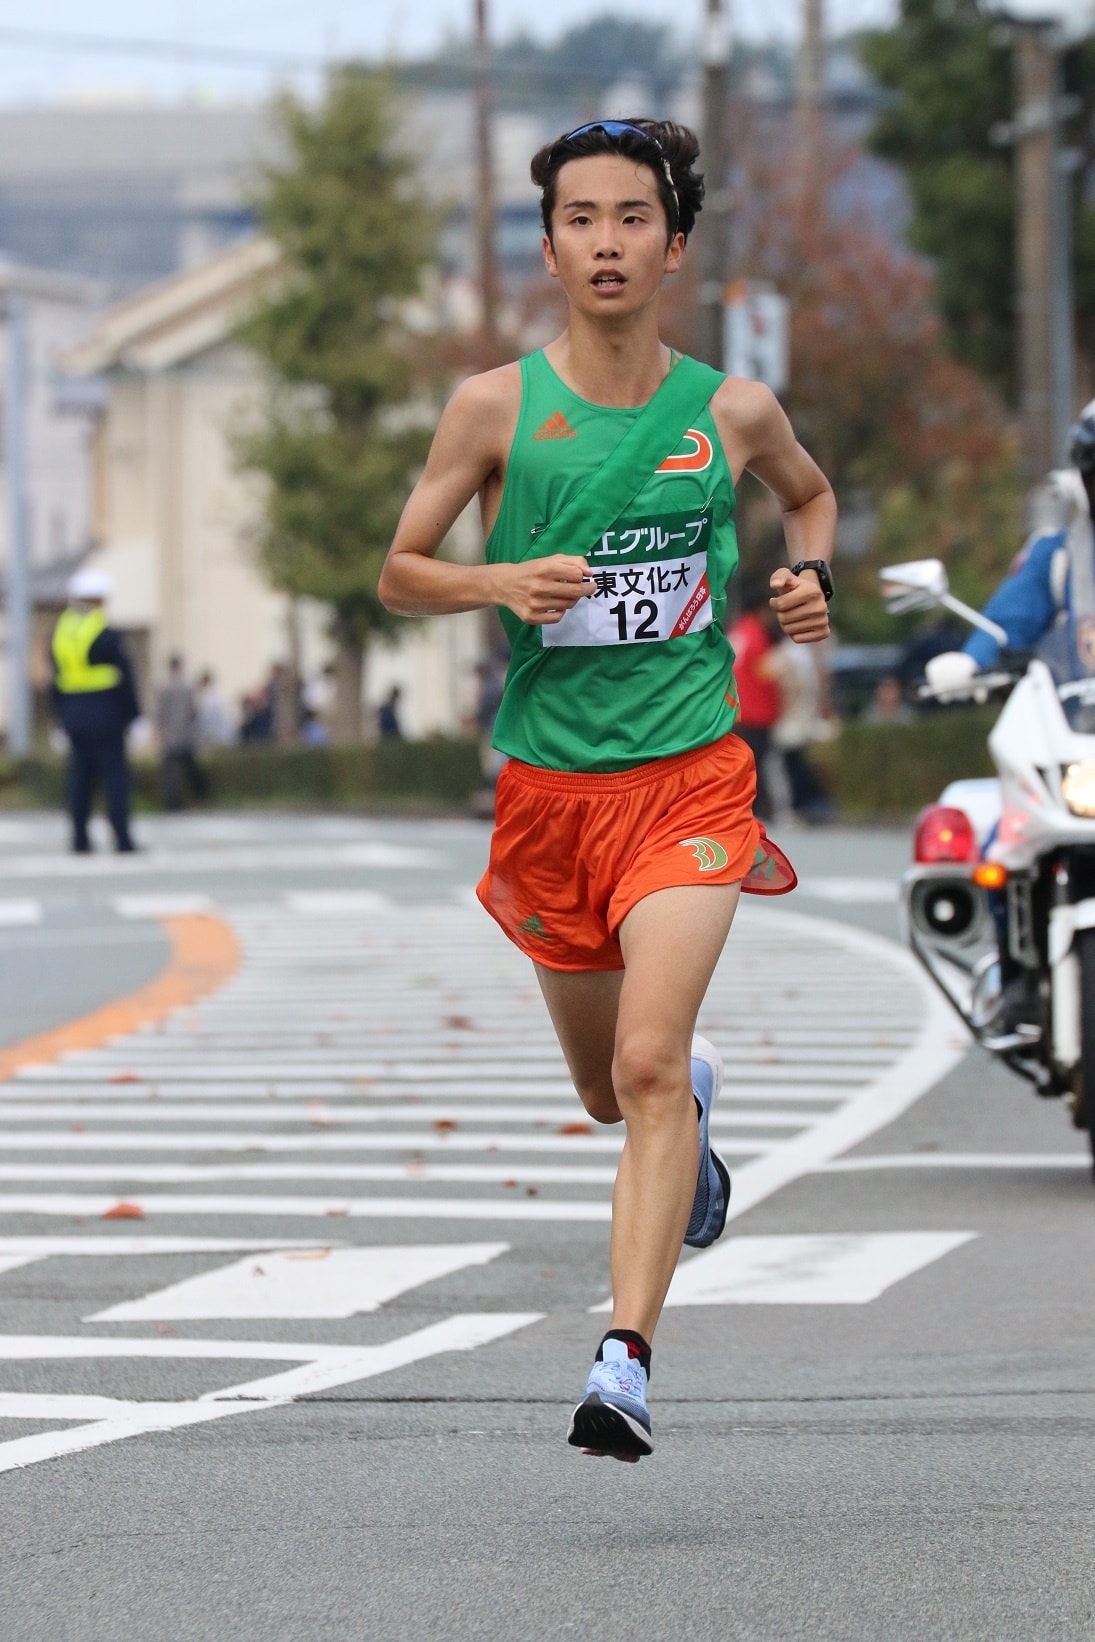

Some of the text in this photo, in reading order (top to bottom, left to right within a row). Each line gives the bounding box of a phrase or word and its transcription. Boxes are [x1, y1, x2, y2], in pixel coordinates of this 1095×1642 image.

[585, 517, 708, 557] 工グループ
[582, 563, 691, 599] 東文化大
[609, 599, 660, 641] 12
[678, 586, 707, 631] がんばろう日本
